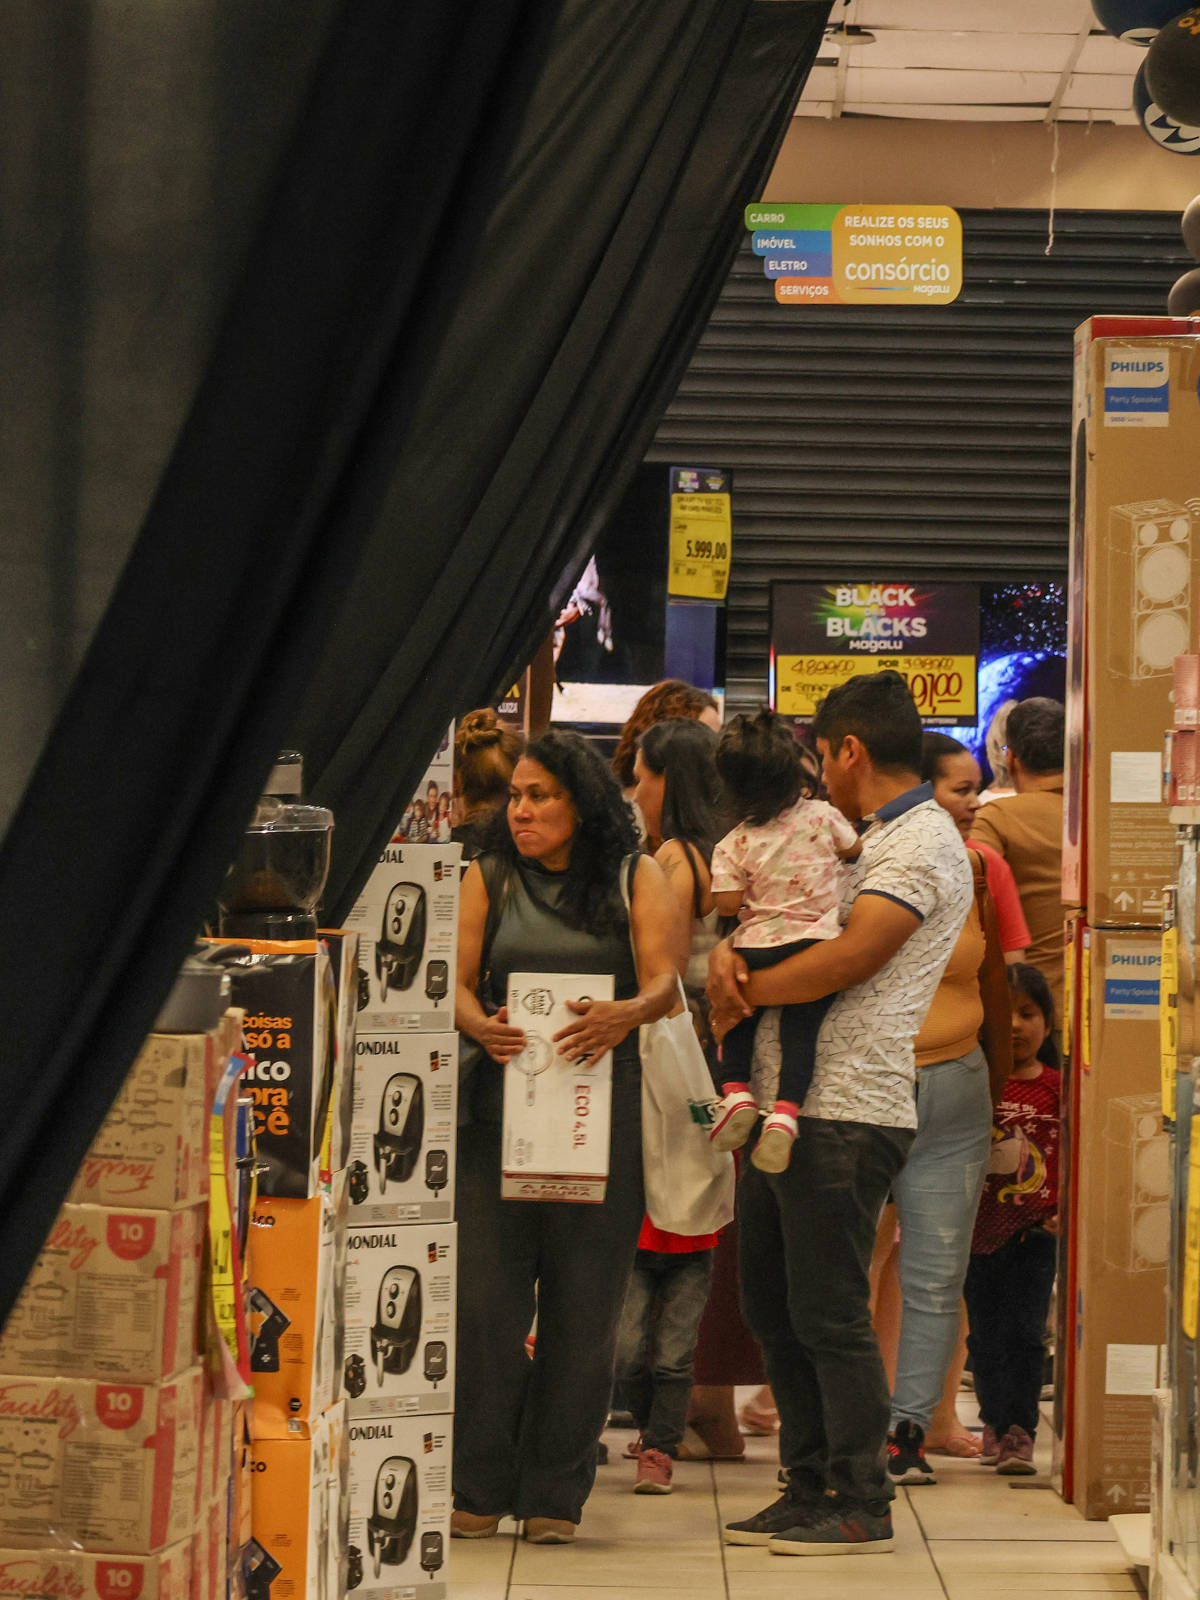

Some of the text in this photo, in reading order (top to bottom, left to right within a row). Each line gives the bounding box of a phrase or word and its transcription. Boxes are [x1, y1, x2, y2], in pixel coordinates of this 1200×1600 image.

[750, 213, 785, 223] CARRO
[845, 216, 949, 229] REALIZE OS SEUS
[757, 236, 796, 249] IMÓVEL
[849, 235, 945, 247] SONHOS COM O
[769, 261, 808, 271] ELETRO
[845, 257, 949, 281] consórcio
[780, 286, 829, 298] SERVIÇOS
[1111, 361, 1164, 373] PHILIPS
[836, 588, 916, 607] BLACK
[826, 617, 928, 637] BLACKS
[1149, 889, 1158, 899] 2
[245, 1029, 291, 1049] só a
[356, 1041, 400, 1055] ONDIAL
[574, 1085, 591, 1117] ECO
[118, 1222, 143, 1242] 10
[107, 1391, 132, 1412] 10
[350, 1425, 393, 1440] ONDIAL
[107, 1569, 132, 1588] 10
